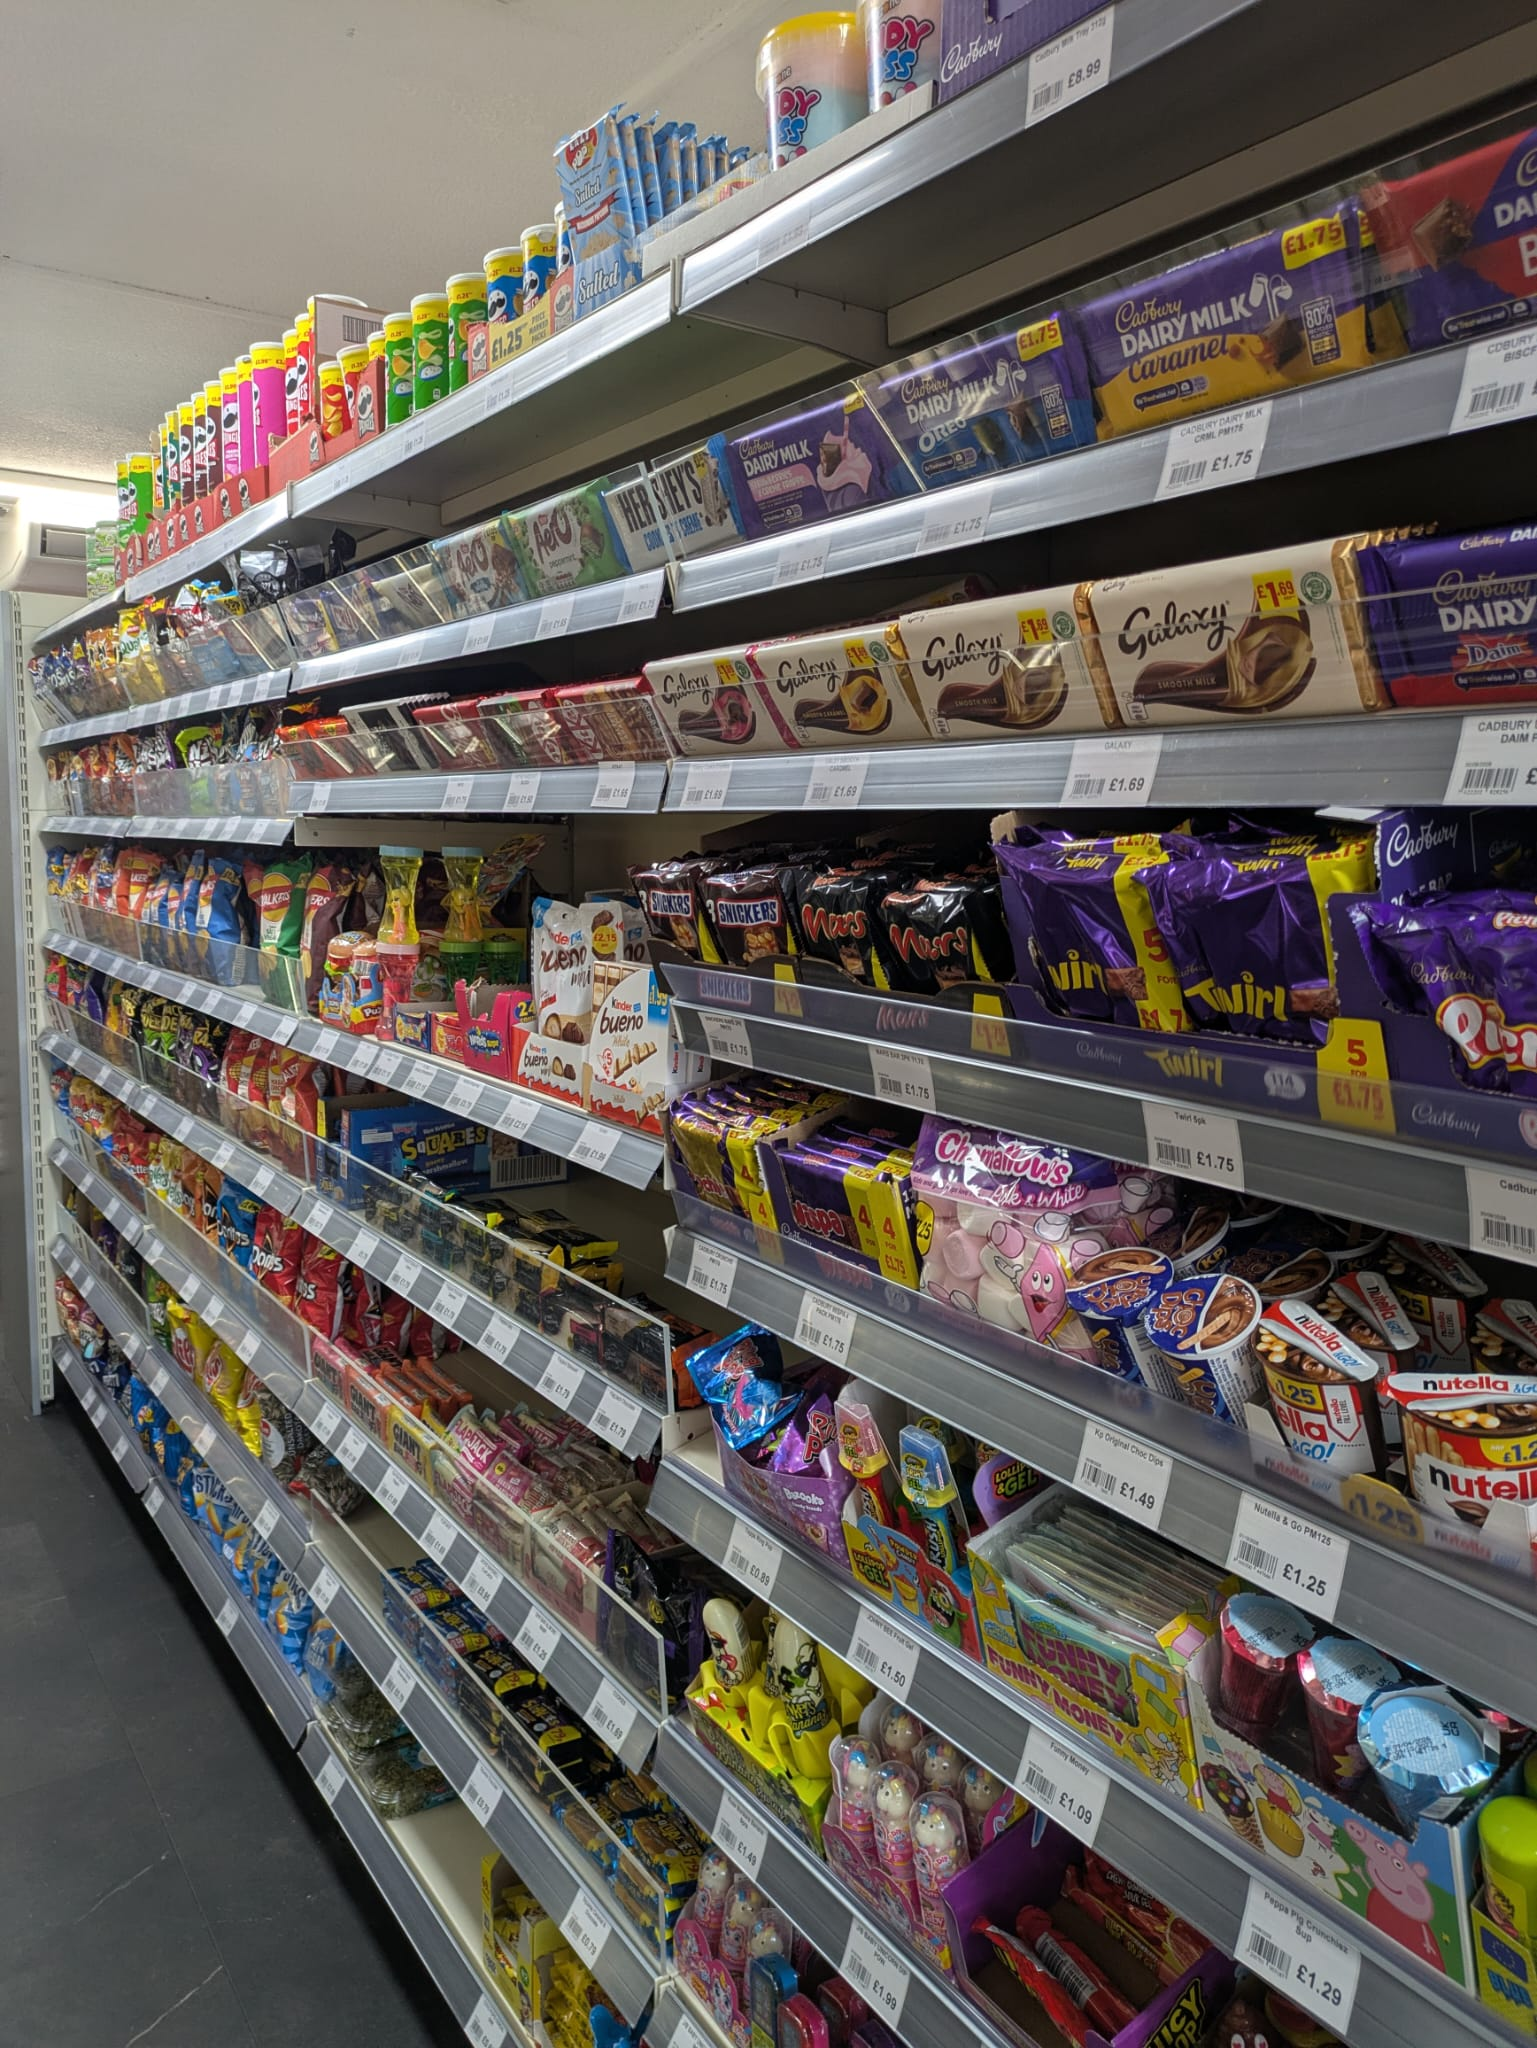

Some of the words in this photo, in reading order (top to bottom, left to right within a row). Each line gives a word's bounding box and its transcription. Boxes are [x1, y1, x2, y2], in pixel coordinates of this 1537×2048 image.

[940, 32, 1003, 84] Cadbury
[1067, 58, 1102, 89] £8.99
[574, 176, 602, 208] Salted
[1284, 222, 1342, 257] £1.75
[578, 261, 619, 305] Salted
[1115, 298, 1182, 335] Cadbury
[1120, 315, 1186, 358] DAIRY
[1190, 292, 1253, 336] MILK
[1304, 303, 1332, 329] 80%
[491, 327, 523, 362] £1.25
[1017, 323, 1058, 350] £1.75
[1487, 334, 1535, 355] CDBURY
[1127, 333, 1230, 384] Caramel
[901, 376, 951, 405] Cadbury
[906, 391, 952, 425] DAIRY
[953, 378, 998, 415] MILK
[918, 418, 967, 453] OREO
[1180, 419, 1218, 438] CADBURY
[1218, 413, 1244, 429] DAIRY
[744, 447, 781, 478] DAIRY
[779, 440, 813, 469] MILK
[1211, 449, 1253, 473] £1.75
[954, 516, 982, 536] £1.75
[800, 556, 823, 574] £1.75
[1256, 580, 1295, 608] £1.69
[1432, 569, 1530, 606] Cadbury
[1021, 616, 1049, 641] £1.69
[1438, 596, 1537, 633] DAIRY
[1118, 601, 1235, 660] Galaxy
[922, 632, 1007, 681] Galaxy
[1467, 643, 1522, 666] Daim
[661, 669, 716, 708] Galaxy
[775, 658, 842, 697] Galaxy
[1157, 678, 1194, 690] SMOOTH
[1194, 676, 1217, 687] MILK
[1478, 718, 1532, 733] CADBURY
[1500, 732, 1530, 744] DAIM
[833, 785, 858, 798] £1.69
[1108, 777, 1145, 792] £1.69
[1386, 819, 1458, 867] Cadbury
[651, 891, 692, 916] SNICKERS
[718, 899, 778, 925] SNICKERS
[802, 903, 867, 943] Mars
[593, 932, 618, 944] £2.15
[889, 923, 969, 963] Mars
[1410, 961, 1476, 985] Cadbury
[701, 973, 751, 1004] SNICKERS
[1184, 971, 1288, 1023] Twirl
[599, 1008, 644, 1035] bueno
[876, 1004, 929, 1031] Mars
[523, 1052, 549, 1069] bueno
[730, 1043, 748, 1057] £1.75
[1347, 1038, 1368, 1067] 5
[1144, 1046, 1224, 1088] Twirl
[905, 1083, 930, 1100] £1.75
[1333, 1079, 1384, 1115] £1.75
[1173, 1110, 1193, 1123] Twirl
[1411, 1102, 1481, 1139] Cadbury
[401, 1125, 487, 1161] SQUARES
[741, 1164, 753, 1183] 4
[1196, 1151, 1235, 1173] £1.75
[758, 1202, 768, 1219] 4
[1036, 1183, 1085, 1210] White
[793, 1201, 846, 1237] Wispa
[858, 1204, 871, 1229] 4
[883, 1216, 896, 1239] 4
[1201, 1247, 1225, 1270] KP
[709, 1279, 728, 1294] £1.75
[822, 1336, 845, 1353] £1.75
[1294, 1313, 1344, 1353] nutella
[1422, 1373, 1509, 1392] nutella
[1104, 1432, 1130, 1453] Original
[1130, 1443, 1148, 1460] Choc
[1147, 1452, 1164, 1468] Dips
[1003, 1468, 1038, 1497] GEL
[1119, 1481, 1155, 1510] £1.49
[1254, 1502, 1282, 1523] Nutella
[1290, 1520, 1303, 1533] Go
[1303, 1526, 1333, 1546] PM125
[749, 1564, 770, 1587] £0.89
[863, 1564, 889, 1587] GEL
[1282, 1563, 1327, 1597] £1.25
[1019, 1621, 1121, 1686] FUNNY
[879, 1661, 906, 1687] £1.50
[985, 1643, 1051, 1698] FUNNY
[1053, 1690, 1124, 1745] MONEY
[1067, 1753, 1090, 1776] Money
[1058, 1792, 1093, 1825] £1.09
[737, 1839, 758, 1867] £1.49
[1263, 1891, 1290, 1916] Peppa
[1289, 1908, 1304, 1926] Pig
[1294, 1924, 1313, 1944] Sup
[872, 1979, 898, 2011] £1.99
[1296, 1963, 1343, 2007] £1.29
